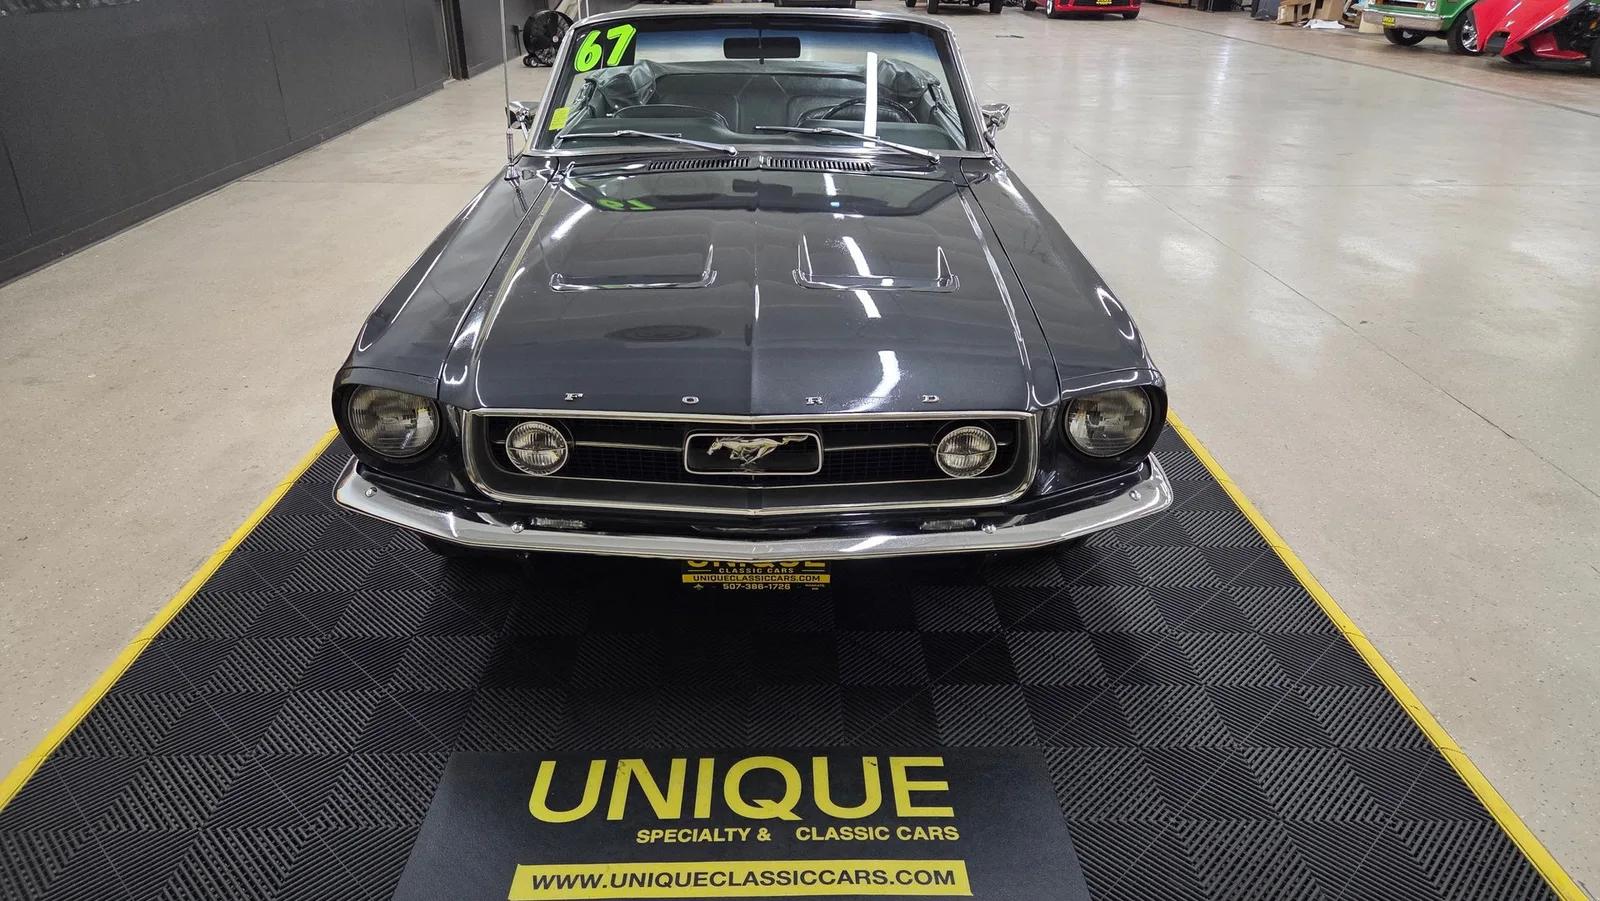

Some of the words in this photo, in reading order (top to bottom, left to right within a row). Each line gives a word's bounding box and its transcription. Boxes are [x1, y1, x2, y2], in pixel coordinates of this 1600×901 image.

[574, 24, 637, 73] 67
[693, 574, 821, 582] UNIQUECLASSICCARS.COM
[528, 756, 955, 823] UNIQUE
[636, 827, 751, 844] SPECIALTY
[756, 827, 772, 842] &
[796, 826, 890, 842] CLASSIC
[896, 826, 960, 841] CARS
[532, 869, 956, 890] WWW.UNIQUECLASSICCARS.COM
